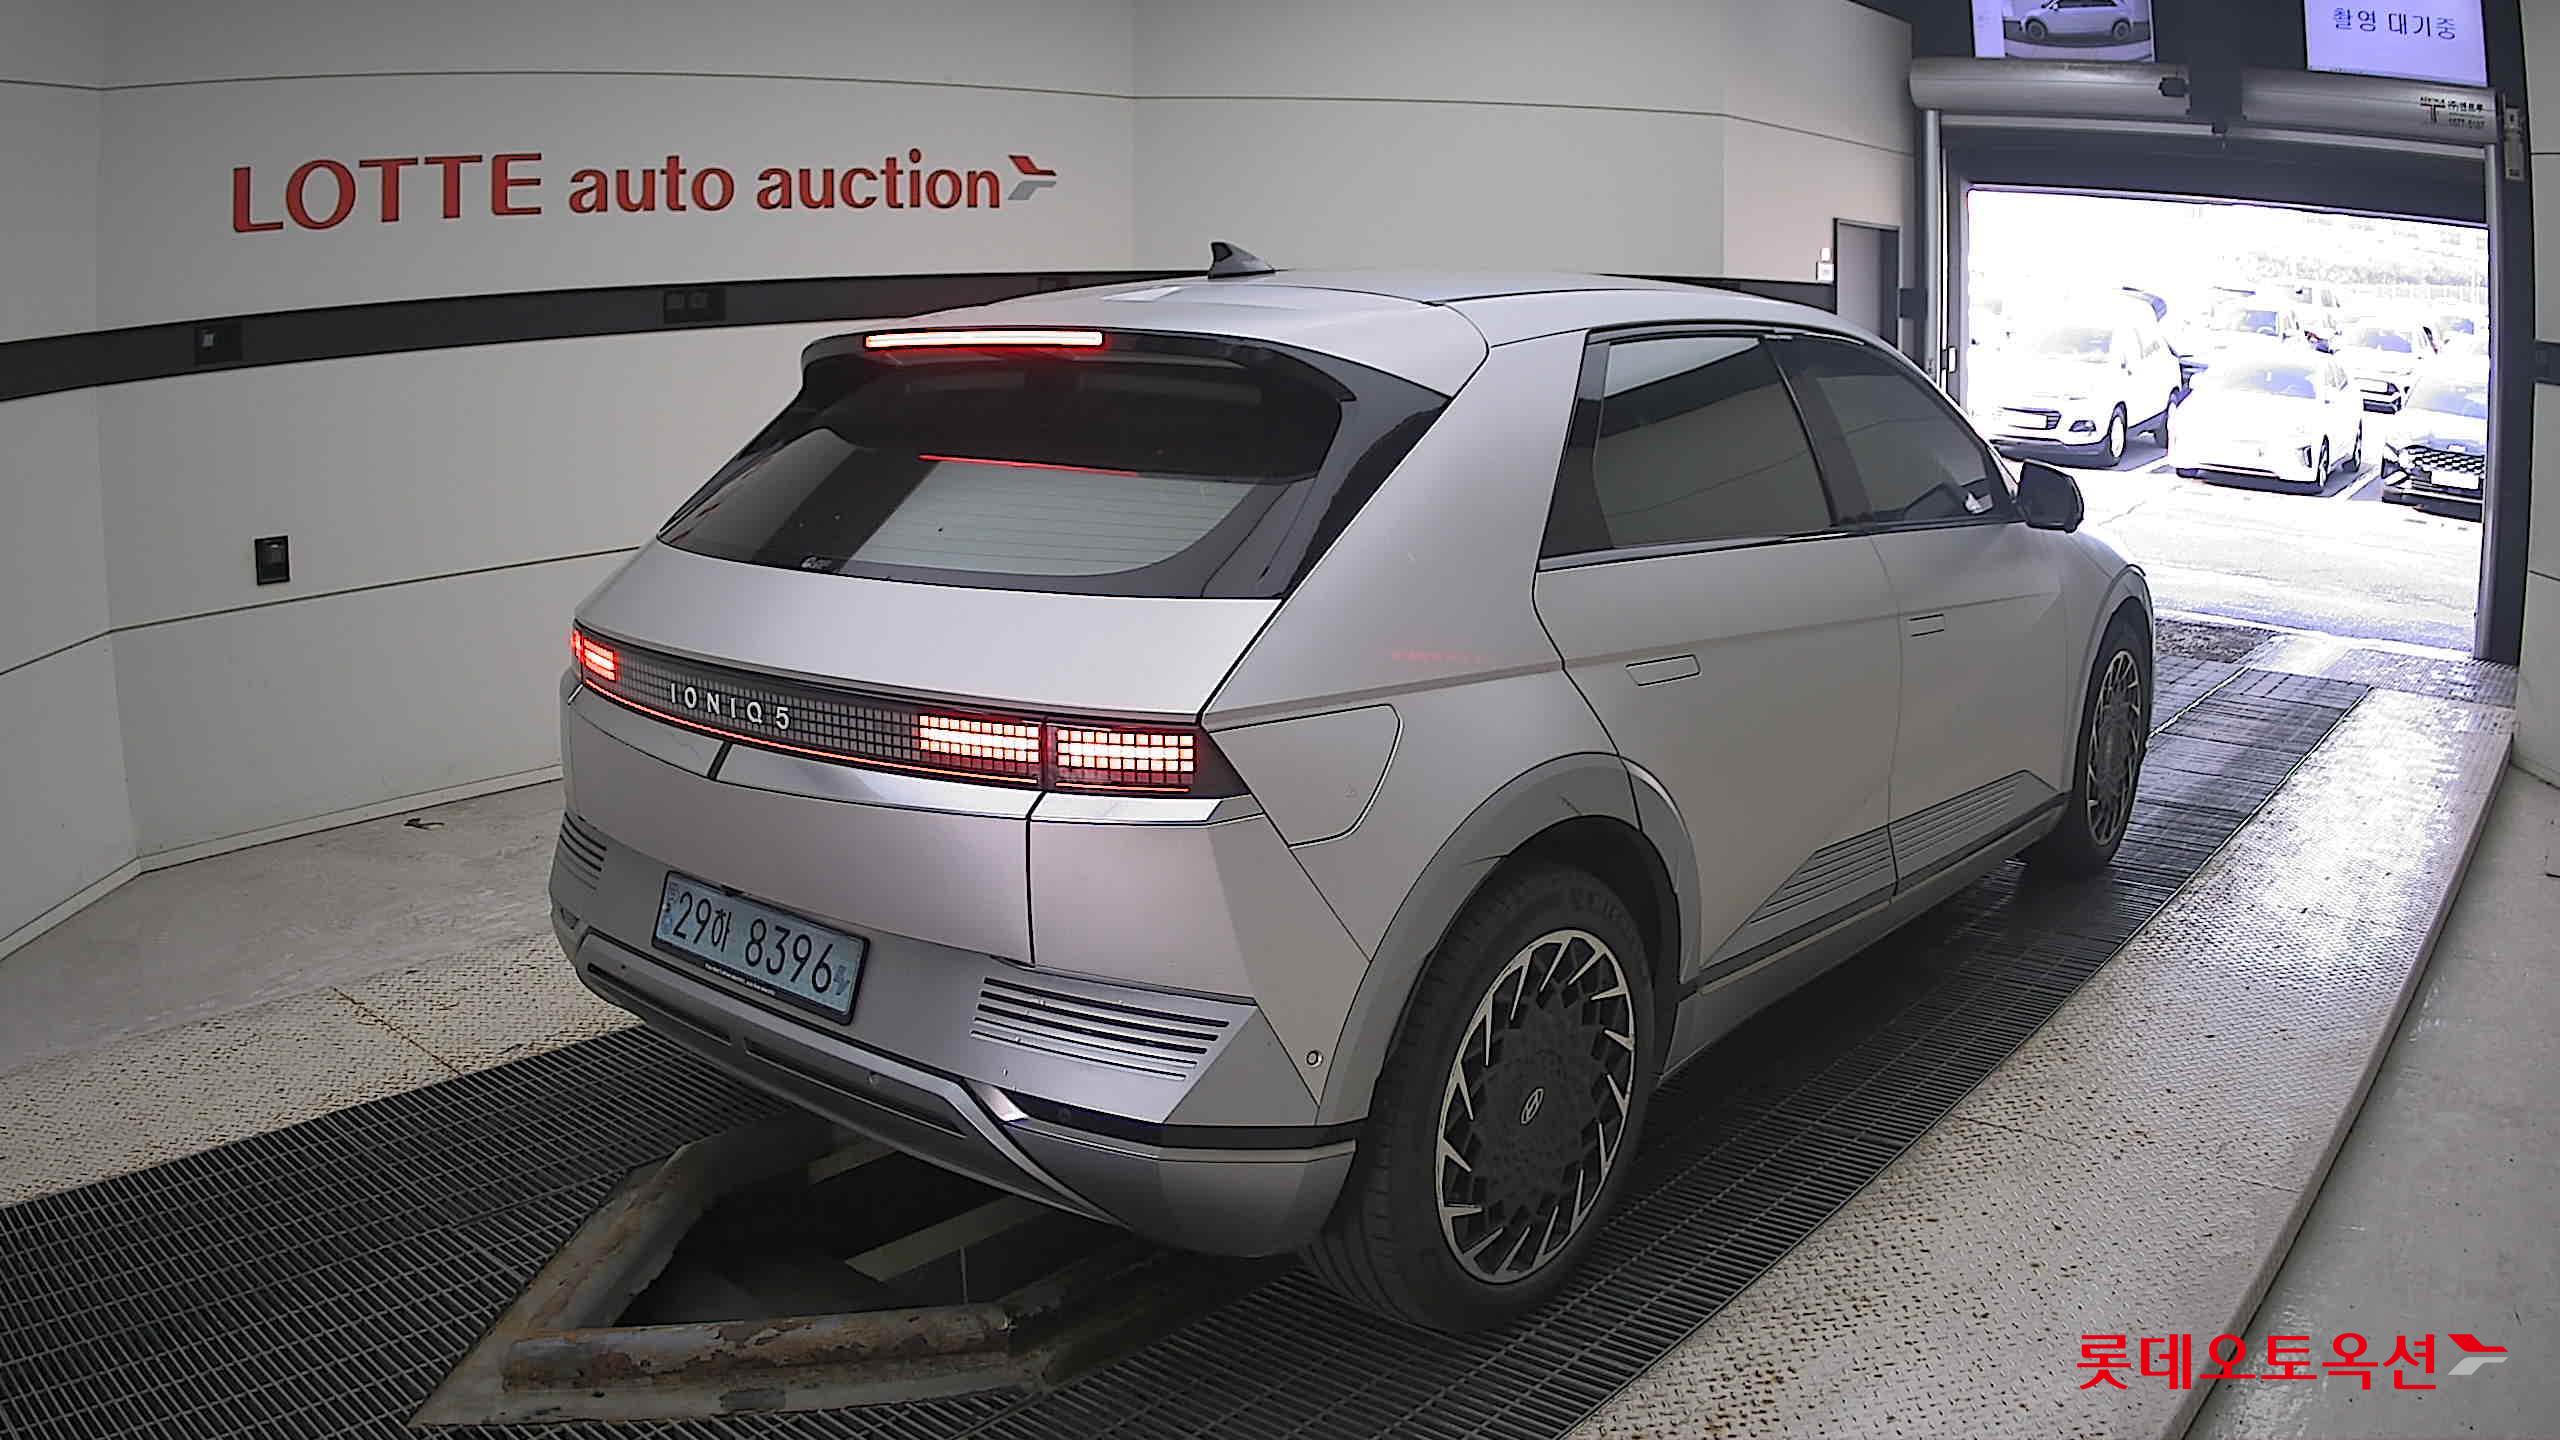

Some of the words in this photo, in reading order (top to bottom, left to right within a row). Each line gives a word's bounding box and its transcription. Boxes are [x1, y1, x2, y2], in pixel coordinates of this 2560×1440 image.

[2333, 7, 2377, 32] 촬영
[2387, 13, 2456, 40] 대기중
[233, 152, 543, 233] LOTTE
[568, 154, 735, 213] auto
[756, 148, 1002, 209] auction
[671, 682, 762, 724] IONIQ
[775, 706, 790, 730] 5
[673, 891, 732, 952] 29하
[745, 918, 833, 993] 8396
